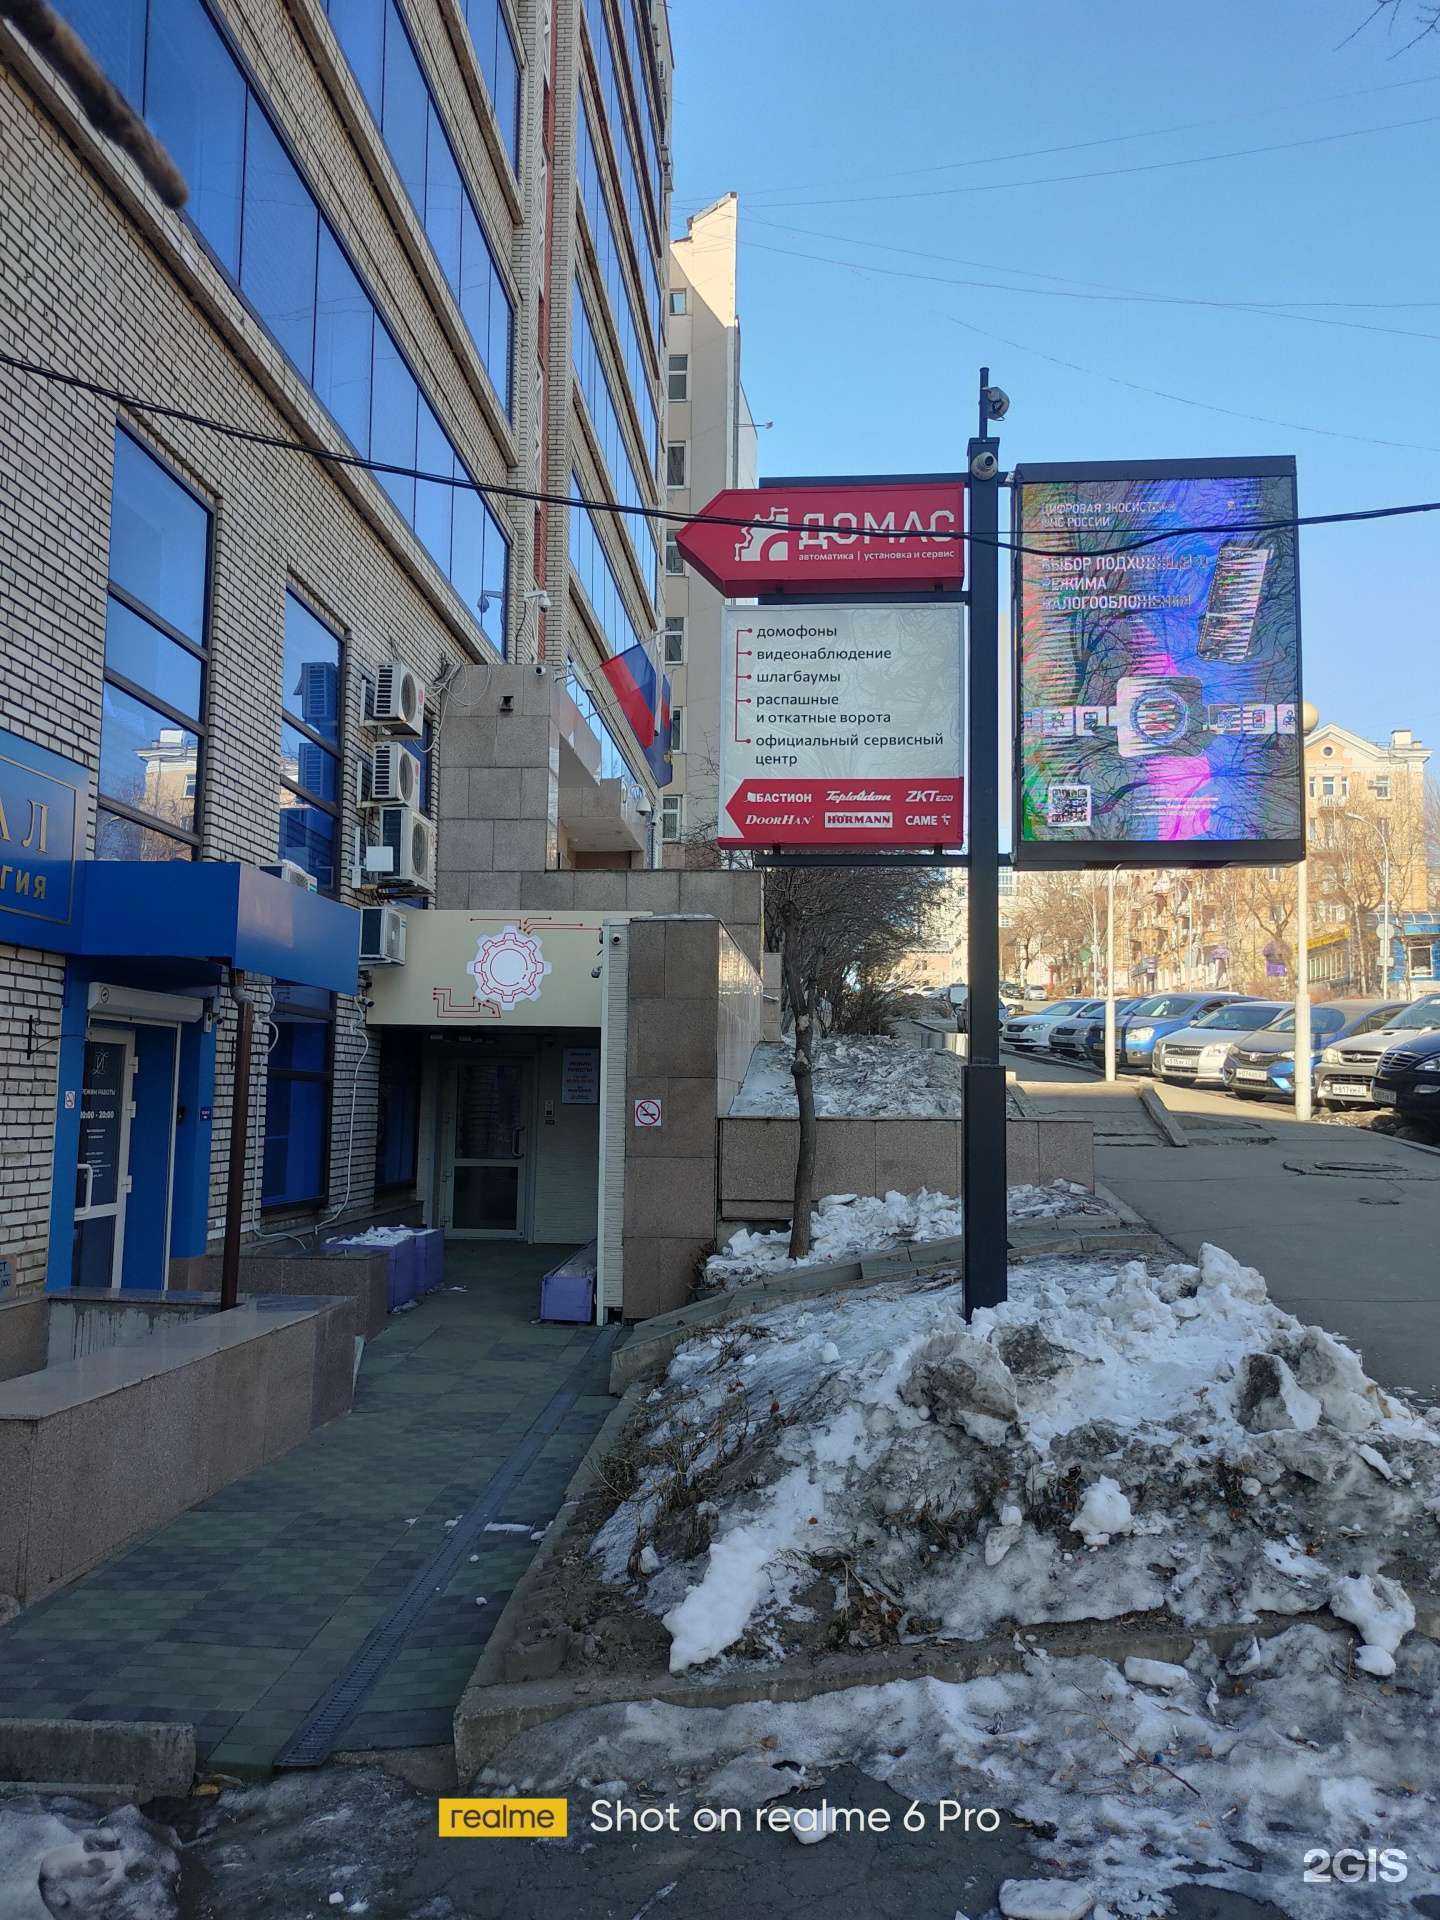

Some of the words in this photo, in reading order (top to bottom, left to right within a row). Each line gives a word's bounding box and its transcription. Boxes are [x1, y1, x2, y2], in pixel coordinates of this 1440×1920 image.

[1067, 517, 1110, 527] РОССИИ
[799, 510, 954, 550] ДОМАС
[799, 552, 854, 561] автоматика
[863, 551, 912, 561] установка
[921, 550, 954, 559] сервис
[756, 624, 837, 640] домофоны
[756, 647, 892, 661] видеонаблюдение
[756, 671, 841, 685] шлагбаумы
[756, 695, 839, 708] распашные
[756, 713, 765, 723] и
[768, 713, 837, 723] откатные
[840, 713, 891, 727] ворота
[755, 734, 859, 749] официальный
[864, 733, 943, 749] сервисный
[755, 754, 798, 767] центр
[756, 793, 812, 803] БАСТИОН
[905, 815, 938, 825] CAME
